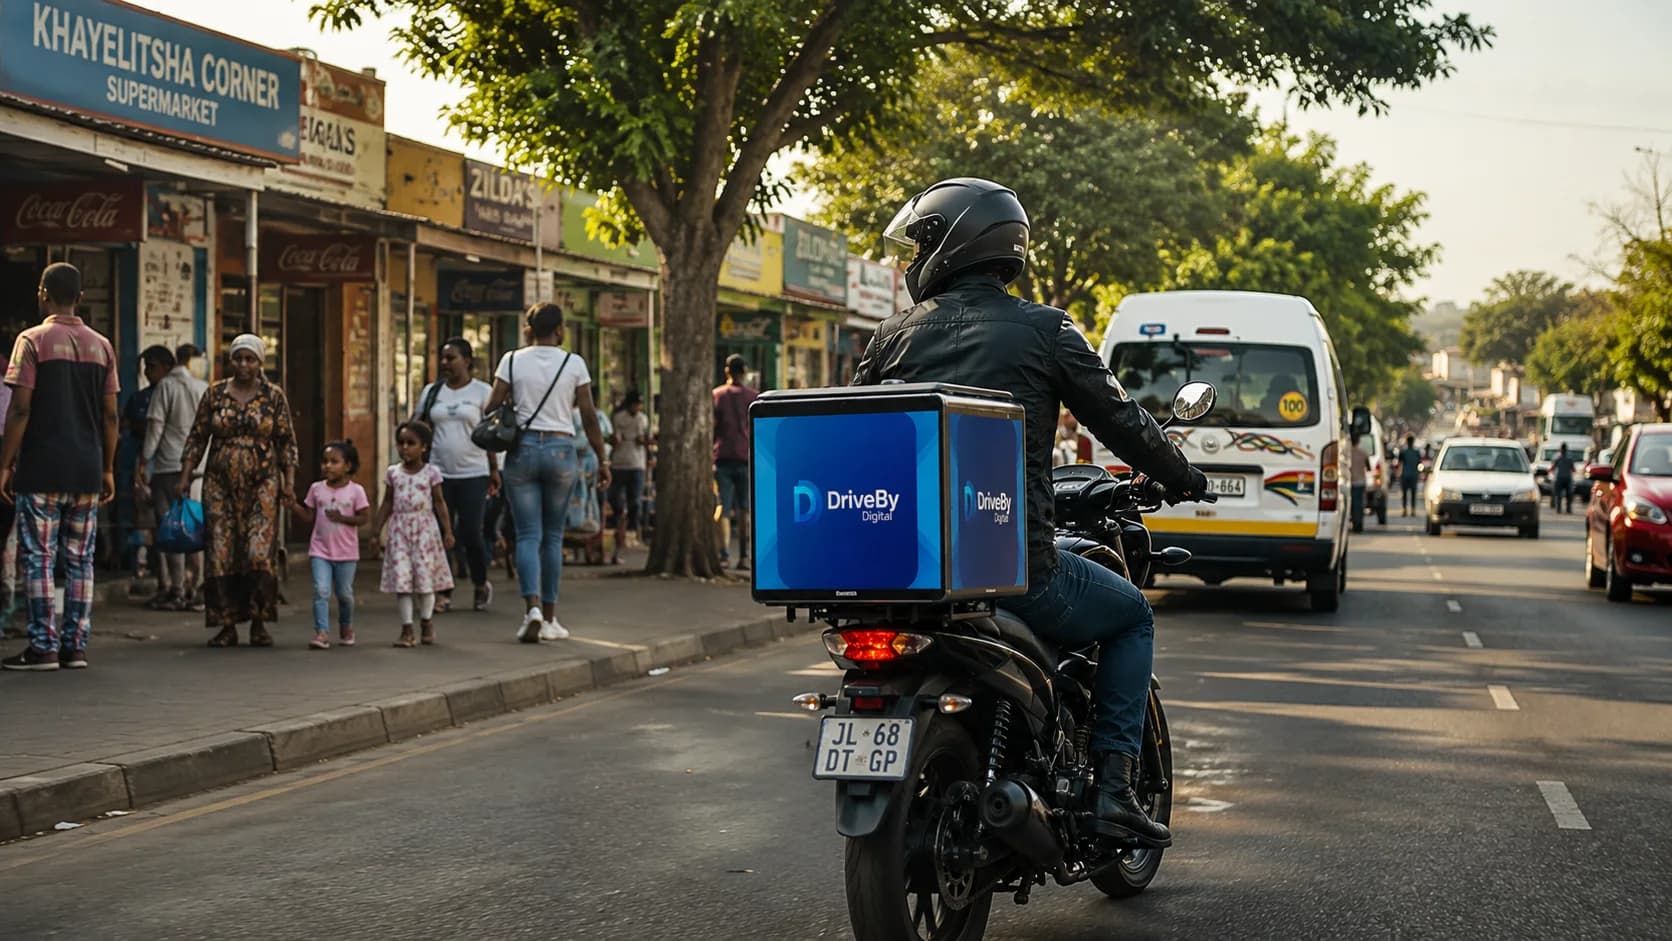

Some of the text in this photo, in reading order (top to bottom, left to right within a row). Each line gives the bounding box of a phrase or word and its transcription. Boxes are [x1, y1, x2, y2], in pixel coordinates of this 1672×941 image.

[33, 2, 280, 110] KHAYELITSHA CORNER
[107, 75, 219, 127] SUPERMARKET
[1283, 398, 1305, 413] 100
[827, 489, 900, 512] DriveBy
[977, 491, 1011, 515] DriveBy
[862, 510, 893, 524] Digital
[832, 722, 900, 746] JL 68
[825, 749, 898, 773] DT GP
